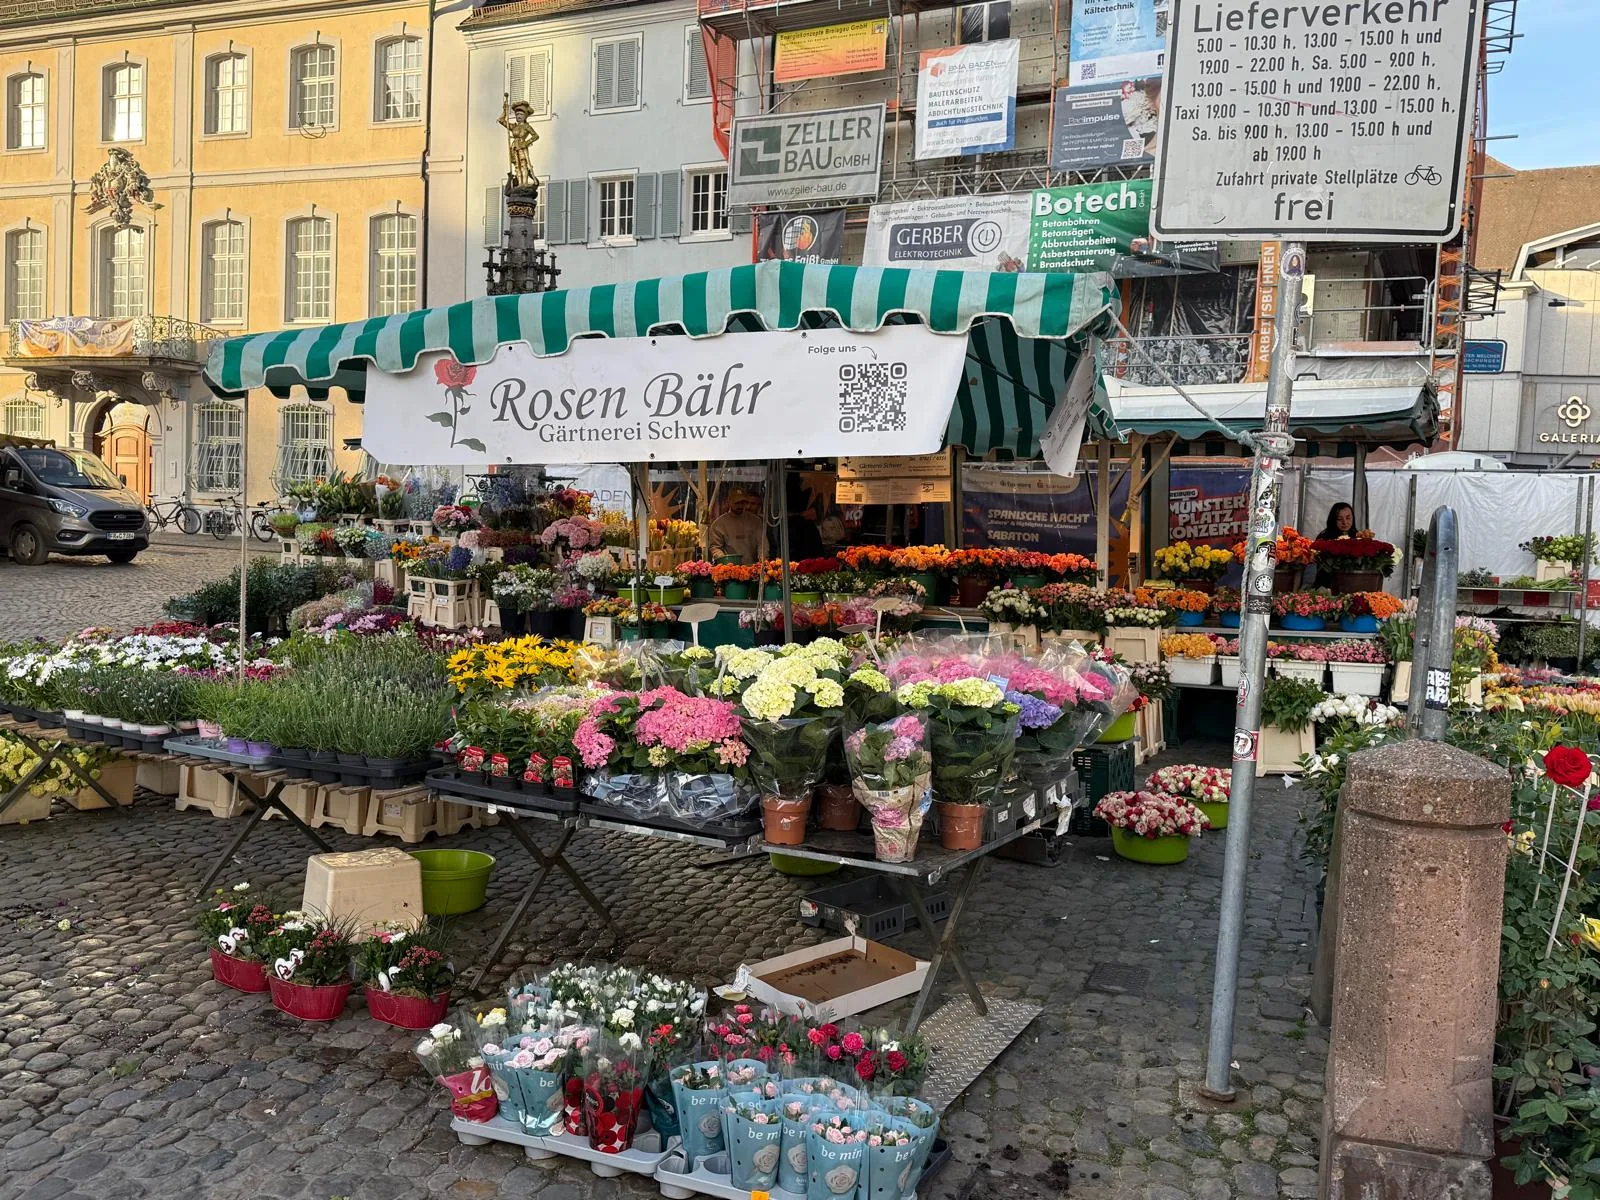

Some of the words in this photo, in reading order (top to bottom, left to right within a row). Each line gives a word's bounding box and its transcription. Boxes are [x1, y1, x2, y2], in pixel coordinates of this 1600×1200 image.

[1084, 2, 1134, 15] Kältetechnik
[1194, 0, 1449, 32] Lieferverkehr
[1197, 38, 1222, 53] 5.00
[1244, 35, 1276, 51] 10.30
[1304, 32, 1337, 48] 13.00
[1360, 30, 1394, 46] 15.00
[1401, 29, 1408, 44] h
[1416, 28, 1442, 43] und
[1200, 59, 1229, 74] 19.00
[1250, 56, 1284, 72] 22.00
[1312, 55, 1332, 70] Sa.
[1340, 53, 1366, 69] 5.00
[1390, 51, 1414, 67] 9.00
[929, 86, 980, 98] BAUTENSCHUTZ
[1192, 82, 1223, 97] 13.00
[1244, 80, 1276, 95] 15.00
[1284, 79, 1291, 94] h
[1298, 78, 1322, 93] und
[1330, 76, 1361, 93] 19.00
[1384, 74, 1420, 91] 22.00
[928, 96, 982, 107] MALERARBEITEN
[928, 103, 1004, 117] ABDICHTUNGSTECHNIK
[1175, 105, 1200, 120] Taxi
[1206, 104, 1236, 119] 19.00
[1258, 102, 1290, 117] 10.30
[1297, 102, 1304, 116] h
[1312, 101, 1336, 115] und
[1344, 99, 1377, 115] 13.00
[1400, 98, 1434, 113] 15.00
[786, 116, 872, 146] ZELLER
[1192, 126, 1211, 141] Sa.
[1218, 125, 1237, 140] bis
[1244, 124, 1268, 139] 9.00
[1296, 123, 1328, 138] 13.00
[1351, 121, 1385, 136] 15.00
[1392, 121, 1399, 136] h
[1407, 120, 1432, 136] und
[784, 146, 833, 173] BAU
[833, 154, 870, 169] GMBH
[1253, 147, 1268, 161] ab
[1276, 146, 1306, 161] 19.00
[1314, 146, 1320, 160] h
[1216, 172, 1264, 186] Zufahrt
[1271, 170, 1318, 189] private
[1325, 168, 1398, 188] Stellplätze
[768, 181, 847, 196] www.zeller-bau.de
[1035, 182, 1136, 216] Botech
[1274, 191, 1334, 221] frei
[1042, 217, 1100, 228] Betonbohren
[897, 224, 962, 246] GERBER
[1042, 228, 1094, 238] Betonsägen
[1041, 236, 1116, 249] Abbrucharbeiten
[894, 248, 962, 259] ELEKTROTECHNIK
[1040, 247, 1116, 259] Asbestsanierung
[1040, 258, 1095, 269] Brandschutz
[808, 346, 835, 354] Folge
[490, 377, 628, 431] Rosen
[644, 363, 772, 418] Bähr
[539, 422, 641, 443] Gärtnerei
[648, 421, 731, 440] Schwer
[1540, 433, 1600, 444] GALERIA
[1170, 496, 1245, 515] MÜNSTER
[988, 509, 1048, 521] SPANISCHE
[1049, 513, 1090, 524] NACHT
[1179, 509, 1233, 526] PLATZ
[988, 530, 1039, 542] SABATON
[539, 1077, 554, 1088] be
[691, 1096, 705, 1105] be
[748, 1128, 763, 1140] be
[783, 1125, 797, 1137] be
[822, 1146, 836, 1158] be
[895, 1152, 909, 1162] be
